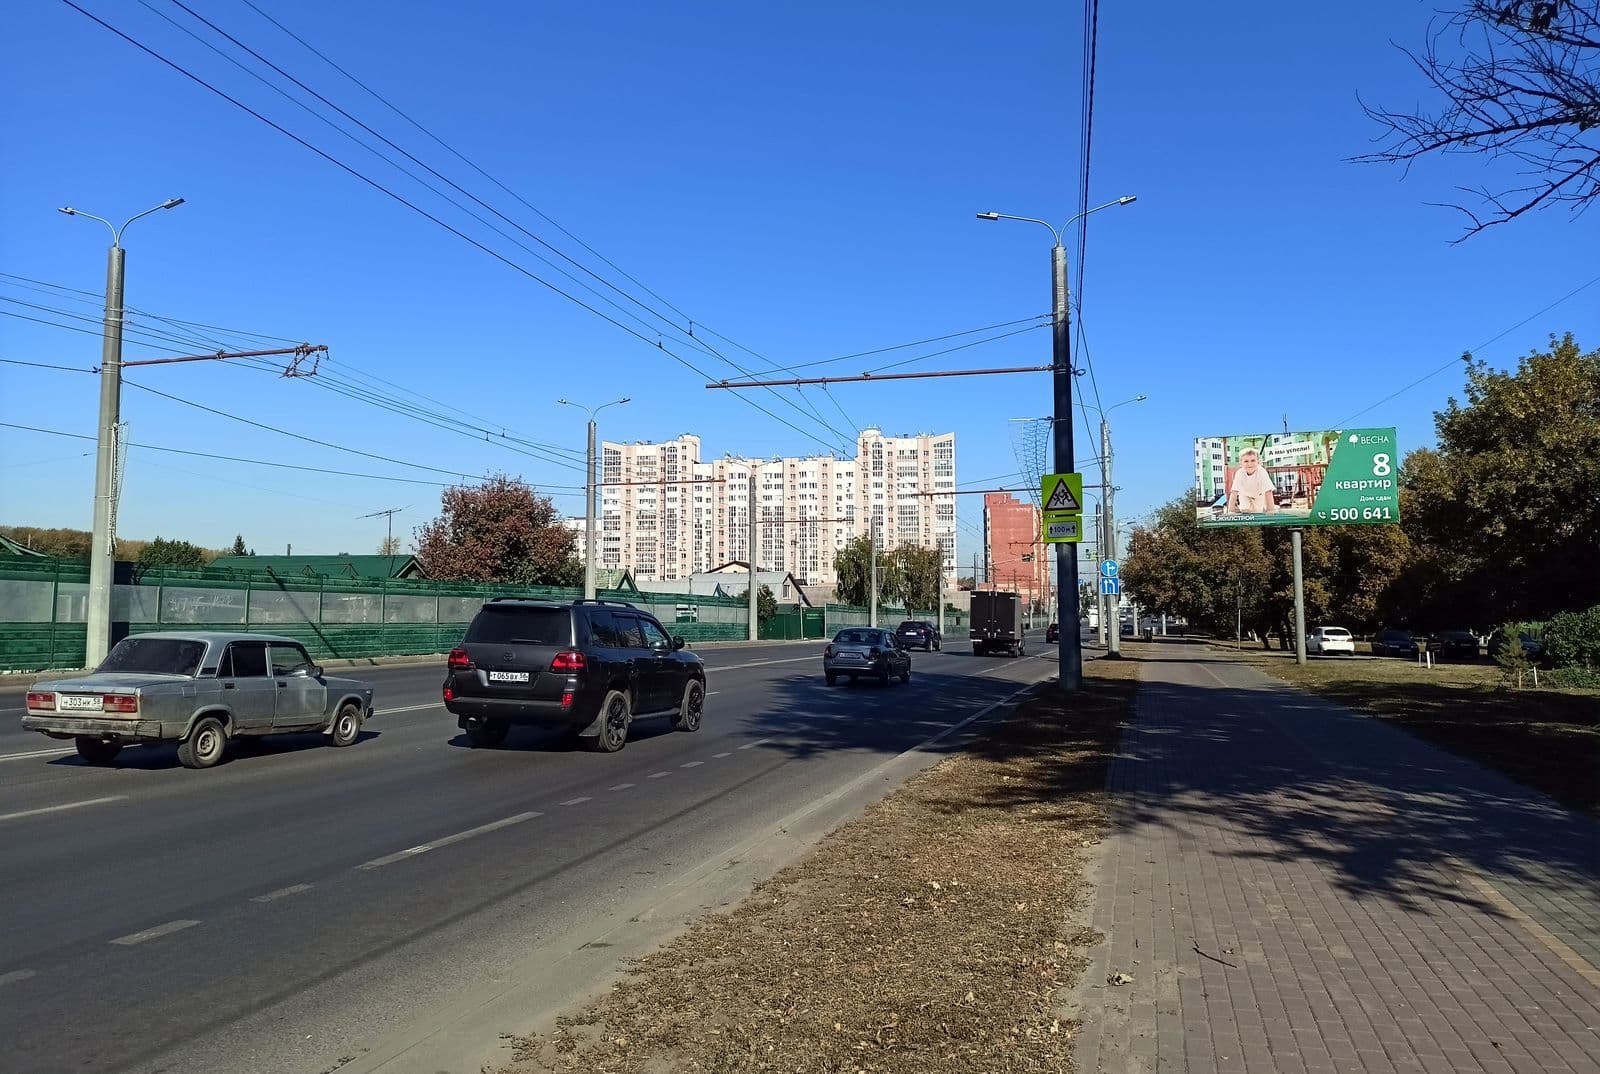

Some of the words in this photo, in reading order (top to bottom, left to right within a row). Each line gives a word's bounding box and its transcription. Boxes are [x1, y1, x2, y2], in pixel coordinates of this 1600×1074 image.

[1360, 435, 1390, 445] ВЕСНА
[1373, 453, 1391, 477] 8
[1335, 479, 1392, 491] квартир
[1375, 494, 1392, 502] сдан
[1330, 507, 1359, 521] 500
[1362, 507, 1391, 520] 641
